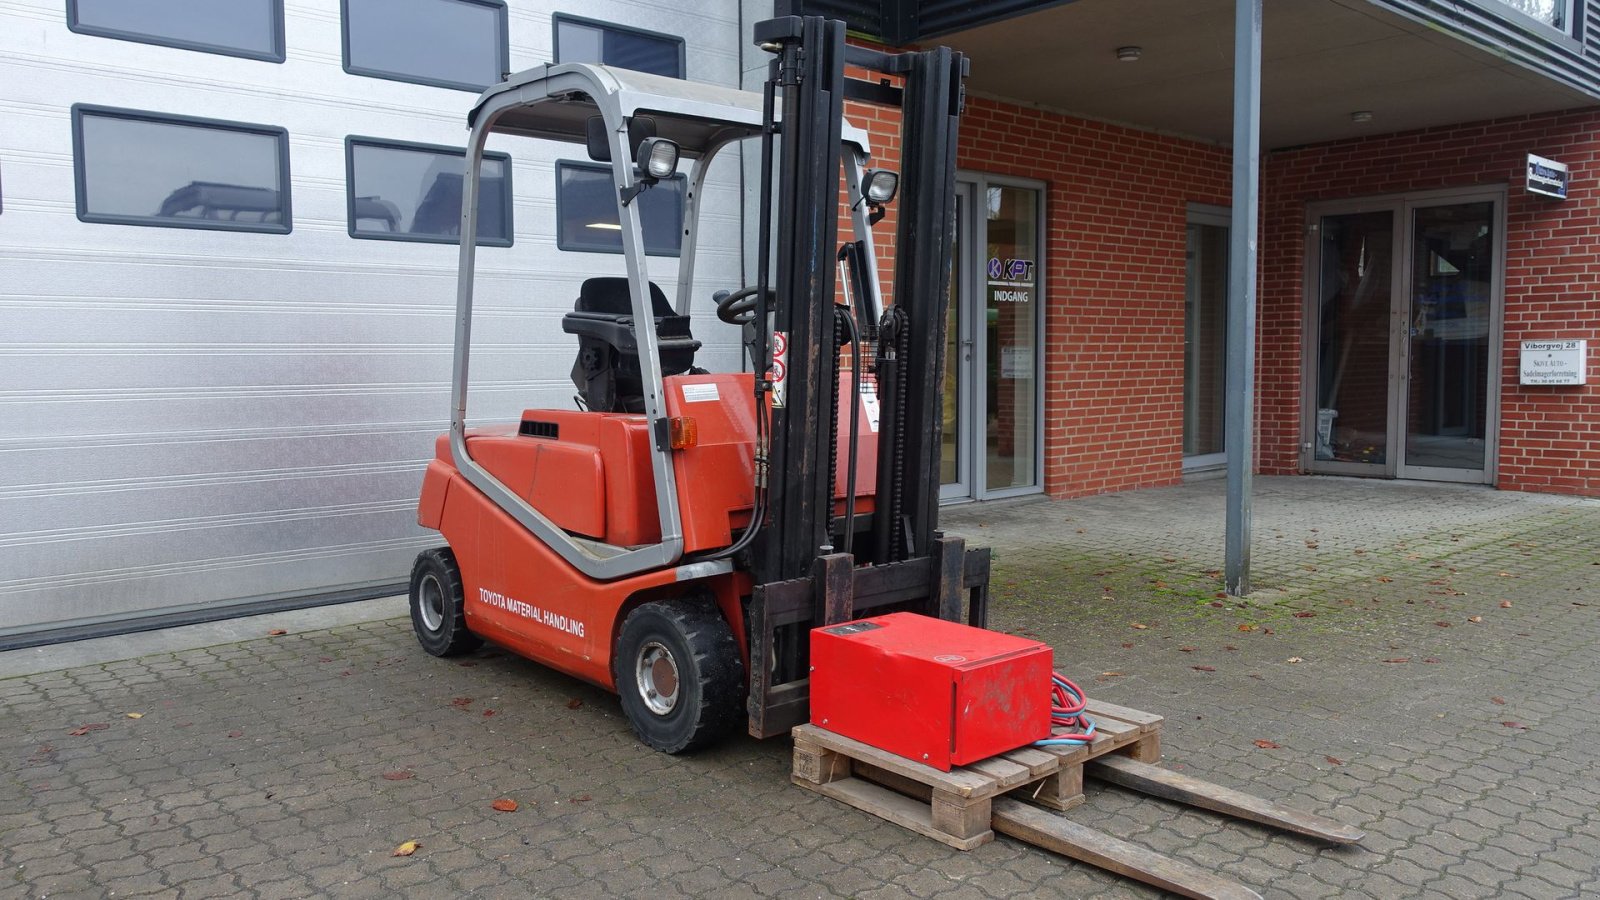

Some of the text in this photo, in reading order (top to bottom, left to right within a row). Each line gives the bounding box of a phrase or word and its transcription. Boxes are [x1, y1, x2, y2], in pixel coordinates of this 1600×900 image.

[1003, 259, 1034, 280] KPT
[994, 290, 1029, 302] INDGANG
[1524, 342, 1564, 350] Viborgvej
[479, 587, 585, 638] TOYOTA MATERIAL HANDLING
